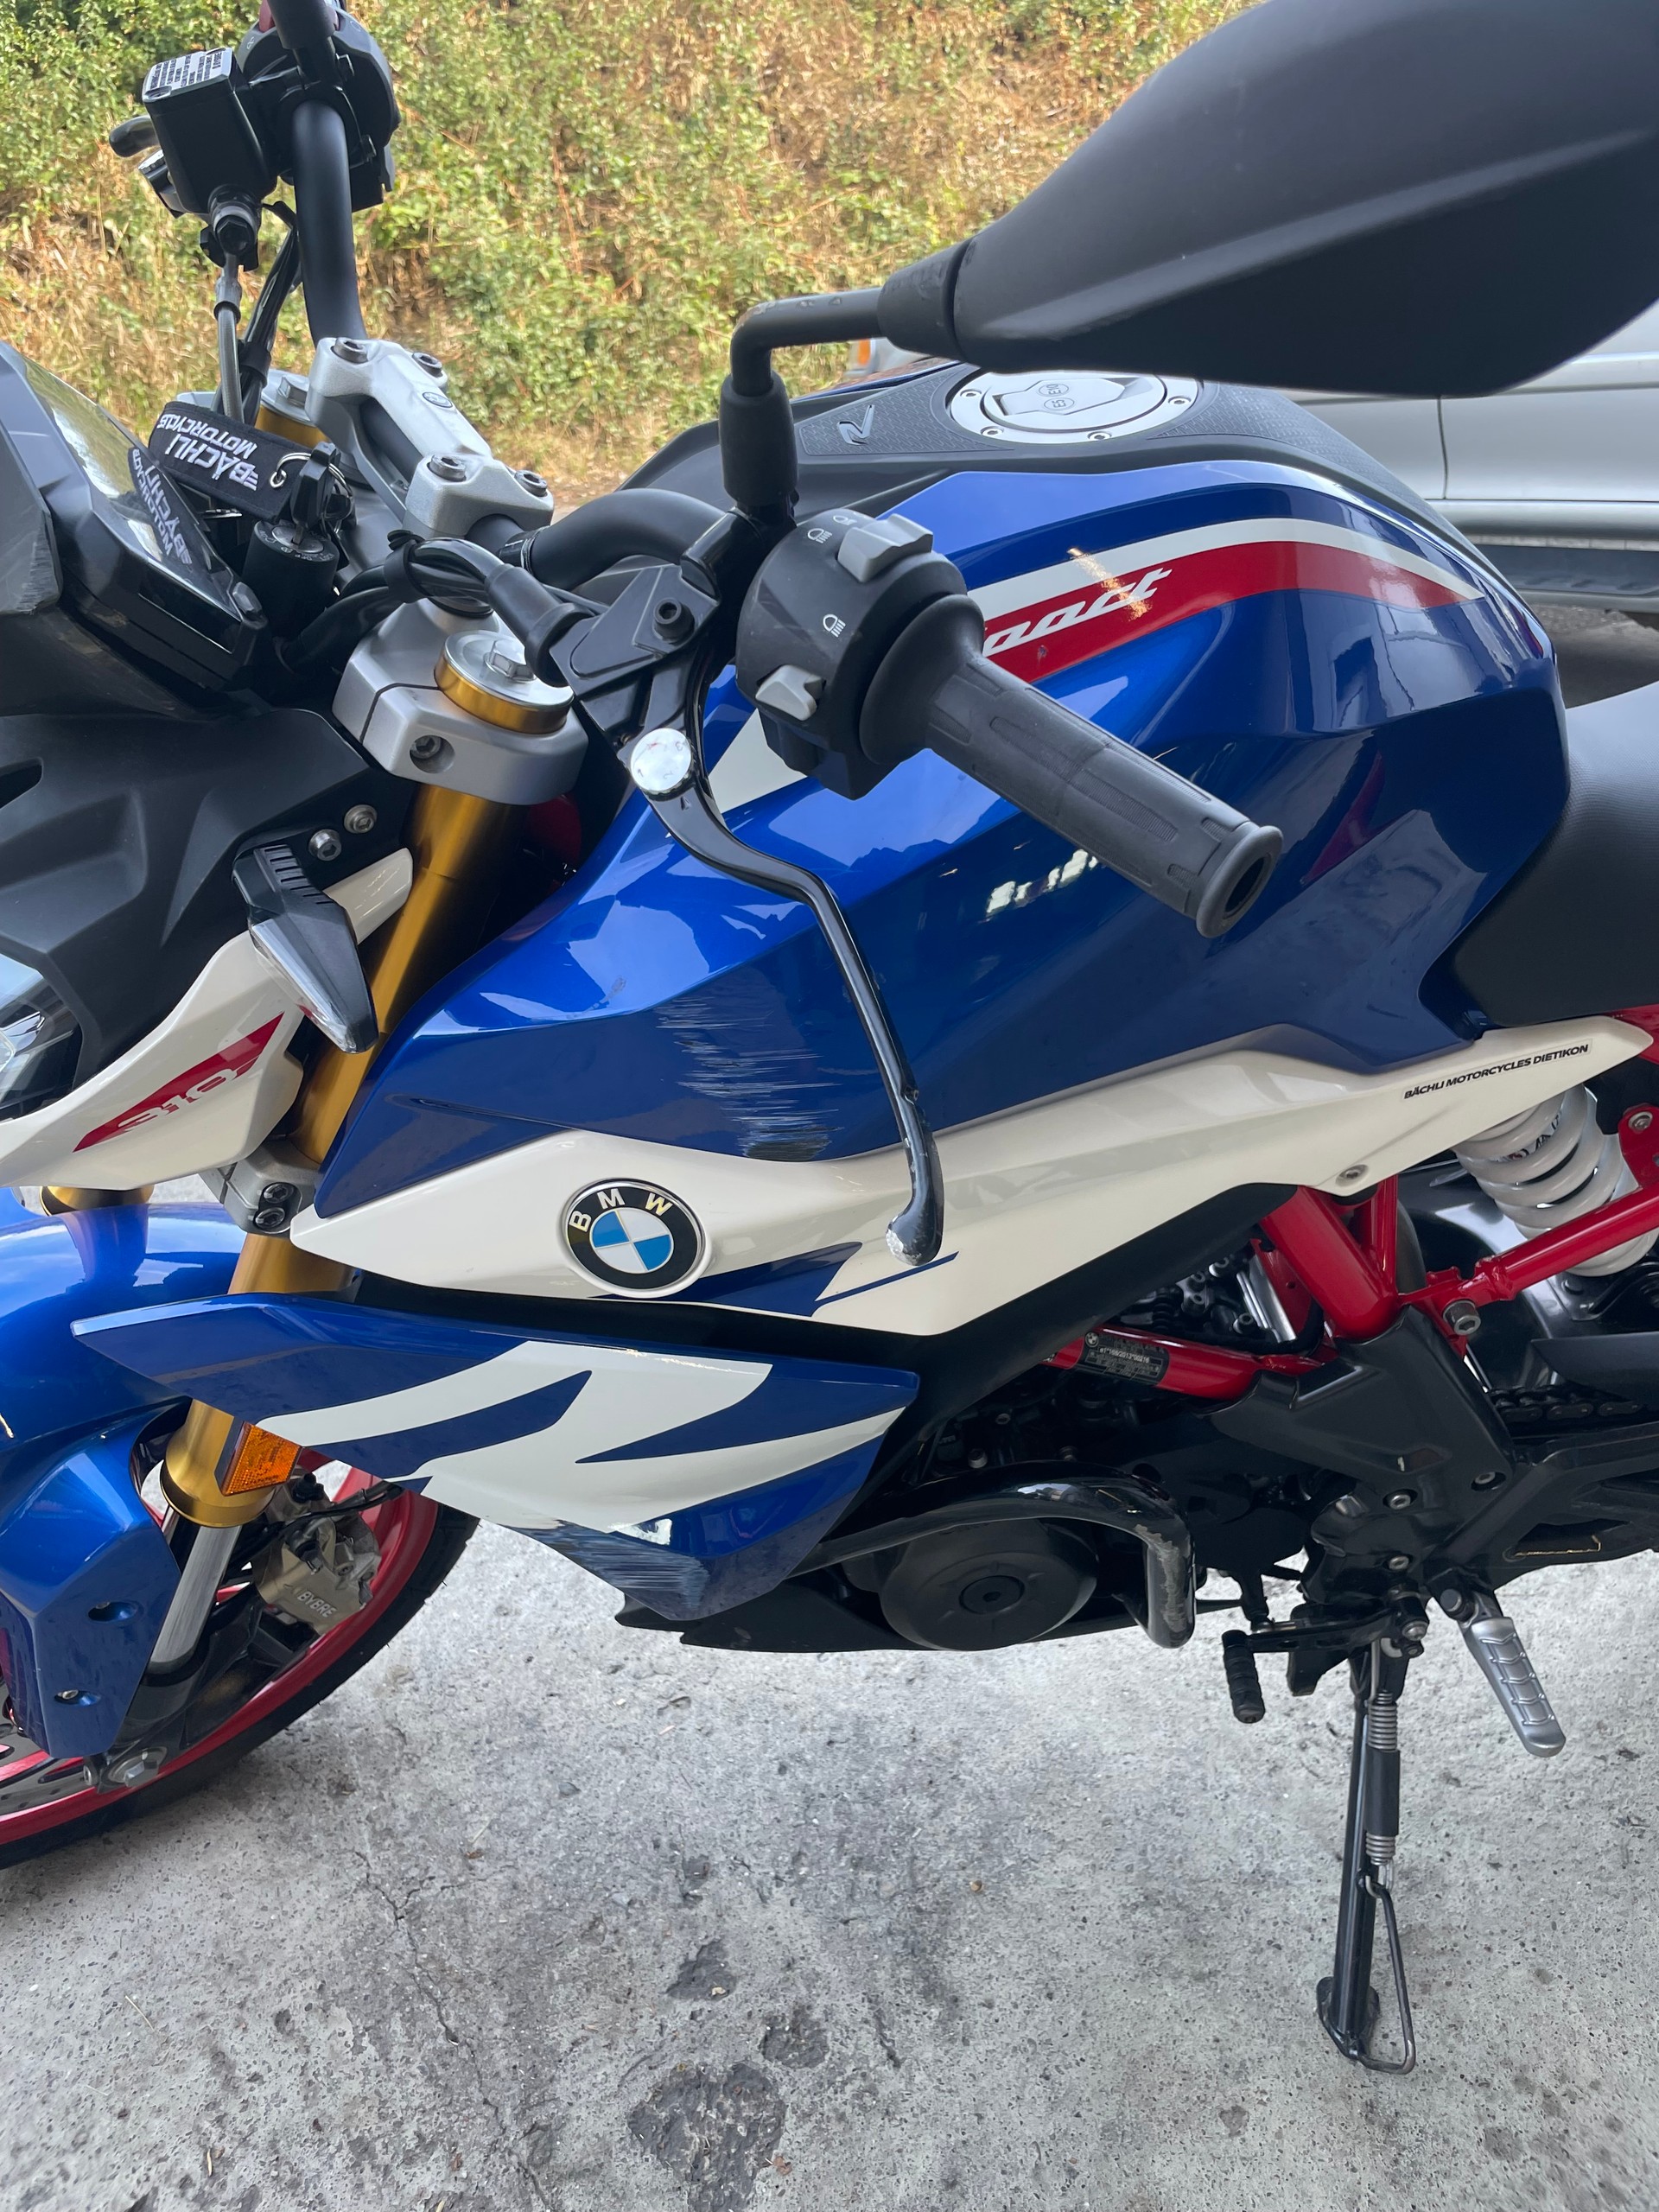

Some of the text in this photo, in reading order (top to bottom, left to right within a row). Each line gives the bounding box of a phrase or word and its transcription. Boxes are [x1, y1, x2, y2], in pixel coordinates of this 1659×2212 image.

[164, 433, 259, 491] BÄCHLI
[1403, 1044, 1589, 1099] BÄCHLI MOTORCYCLES DIETIKON
[118, 1067, 239, 1132] 310
[569, 1187, 674, 1233] BMW
[296, 1591, 337, 1618] BYBRE
